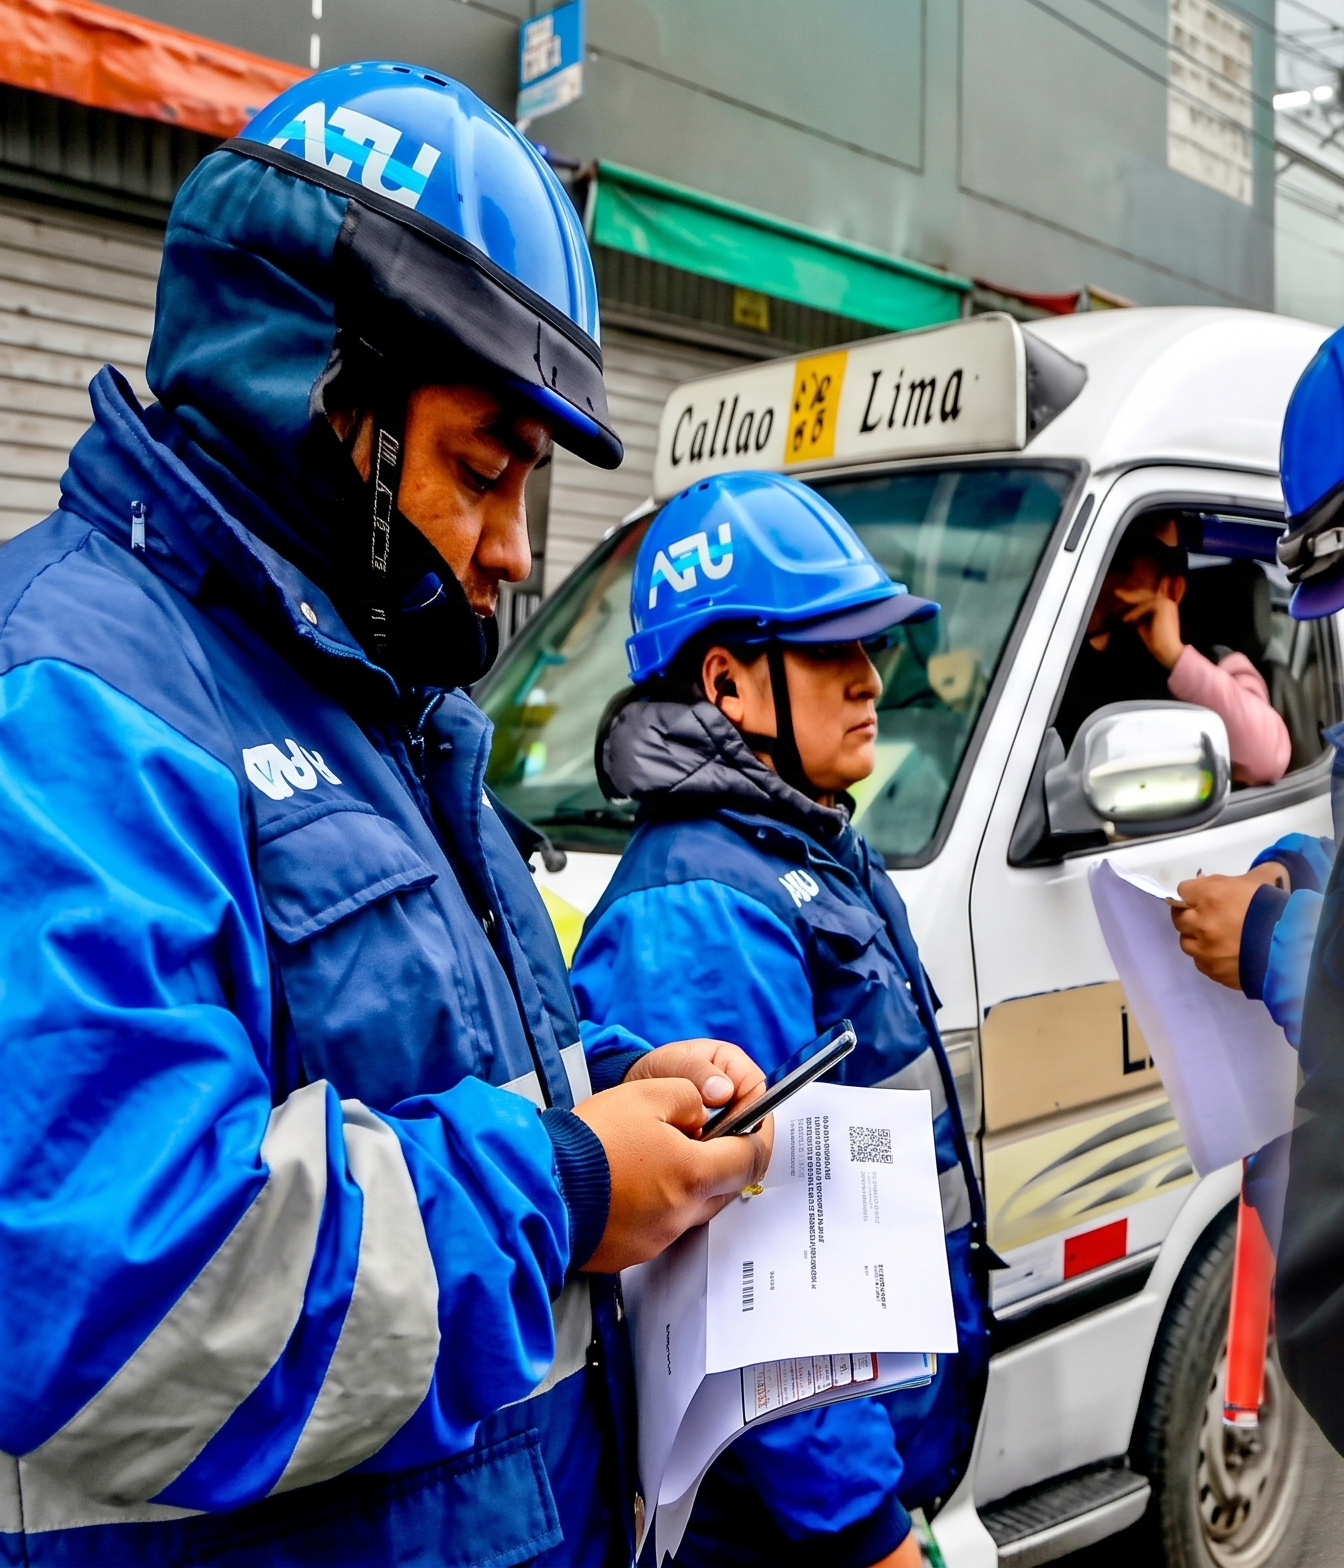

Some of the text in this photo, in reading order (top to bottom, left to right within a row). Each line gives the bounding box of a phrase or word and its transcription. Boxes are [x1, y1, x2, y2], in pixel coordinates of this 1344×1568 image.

[267, 101, 442, 210] ATU
[670, 393, 775, 467] Callao
[859, 366, 964, 434] Lima
[648, 522, 734, 610] ATU
